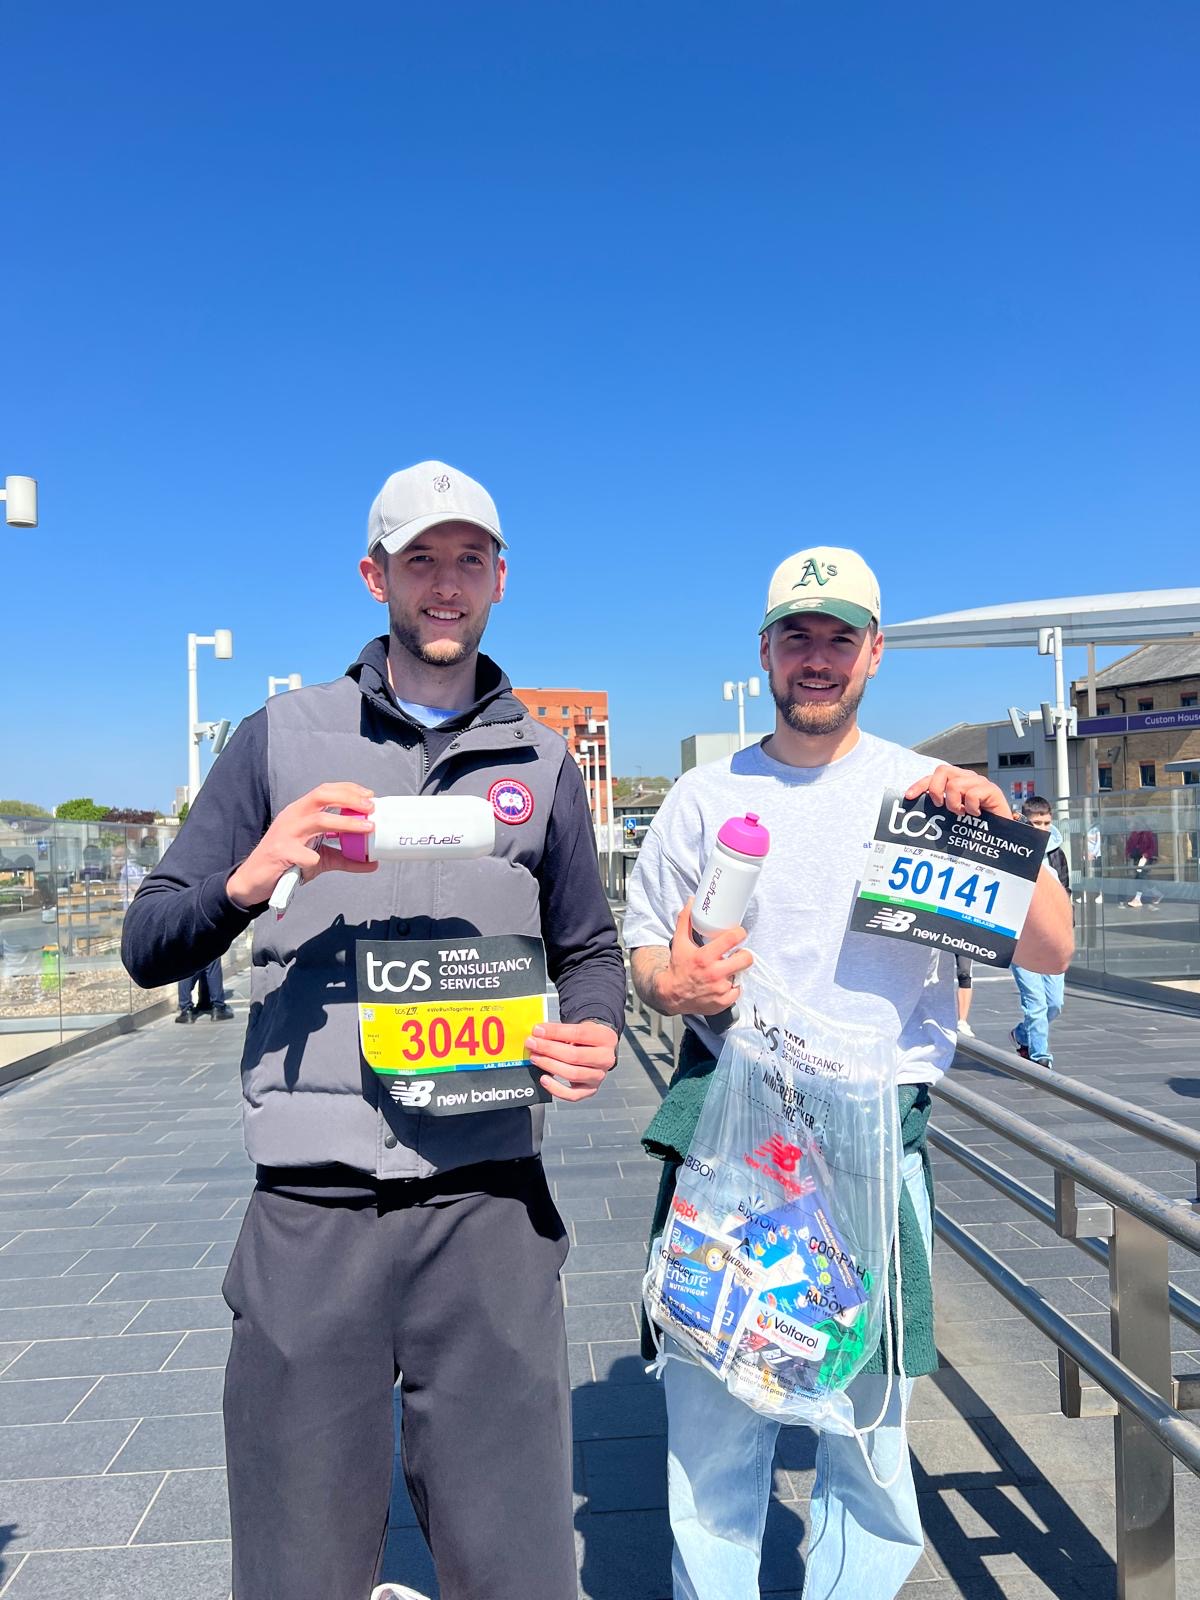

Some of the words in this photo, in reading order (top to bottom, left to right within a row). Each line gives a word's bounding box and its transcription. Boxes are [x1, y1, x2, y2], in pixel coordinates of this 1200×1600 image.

[792, 558, 838, 590] A's
[1144, 716, 1176, 725] Custom
[888, 799, 946, 841] tcs
[956, 814, 989, 832] TATA
[399, 834, 463, 846] truefuels
[947, 836, 1001, 859] SERVICES
[951, 824, 1034, 858] CONSULTANCY
[888, 856, 1001, 915] 50141
[438, 949, 479, 961] TATA
[912, 927, 941, 944] new
[941, 932, 998, 960] balance
[367, 952, 432, 992] tcs
[439, 957, 532, 976] CONSULTANCY
[440, 976, 500, 990] SERVICES
[402, 1016, 505, 1061] 3040
[783, 1029, 806, 1049] TATA
[781, 1050, 816, 1076] SERVICES
[783, 1039, 844, 1073] CONSULTANCY
[437, 1093, 469, 1107] new
[471, 1087, 535, 1103] balance
[738, 1200, 777, 1232] BUXTON
[722, 1250, 753, 1277] Lucozade
[805, 1289, 848, 1316] RADOX
[775, 1317, 819, 1349] Voltarol
